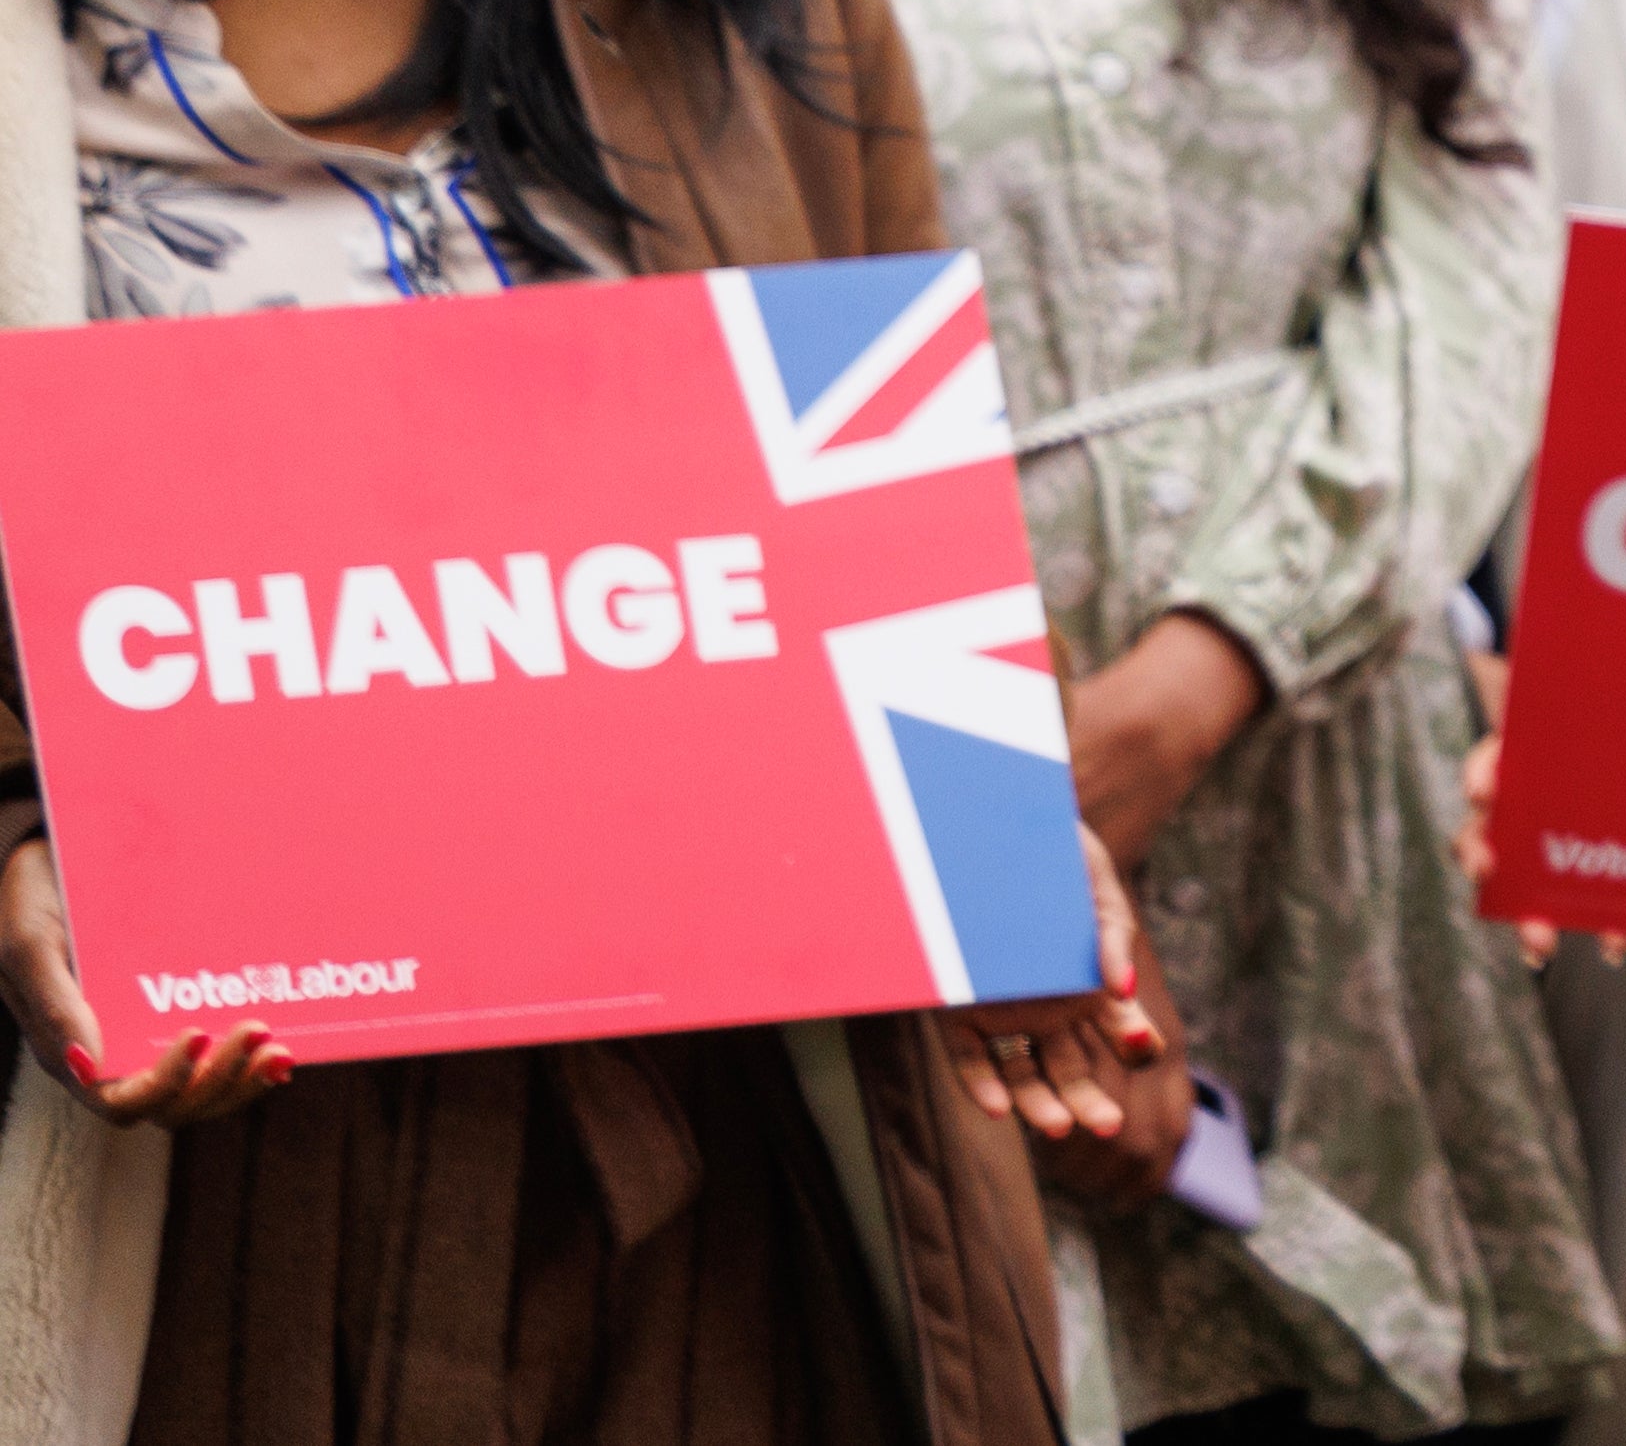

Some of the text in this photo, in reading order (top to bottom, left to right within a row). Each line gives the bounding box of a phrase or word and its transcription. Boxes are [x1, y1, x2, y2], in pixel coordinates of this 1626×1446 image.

[78, 532, 780, 713] CHANGE
[139, 957, 420, 1013] Vote Labour
